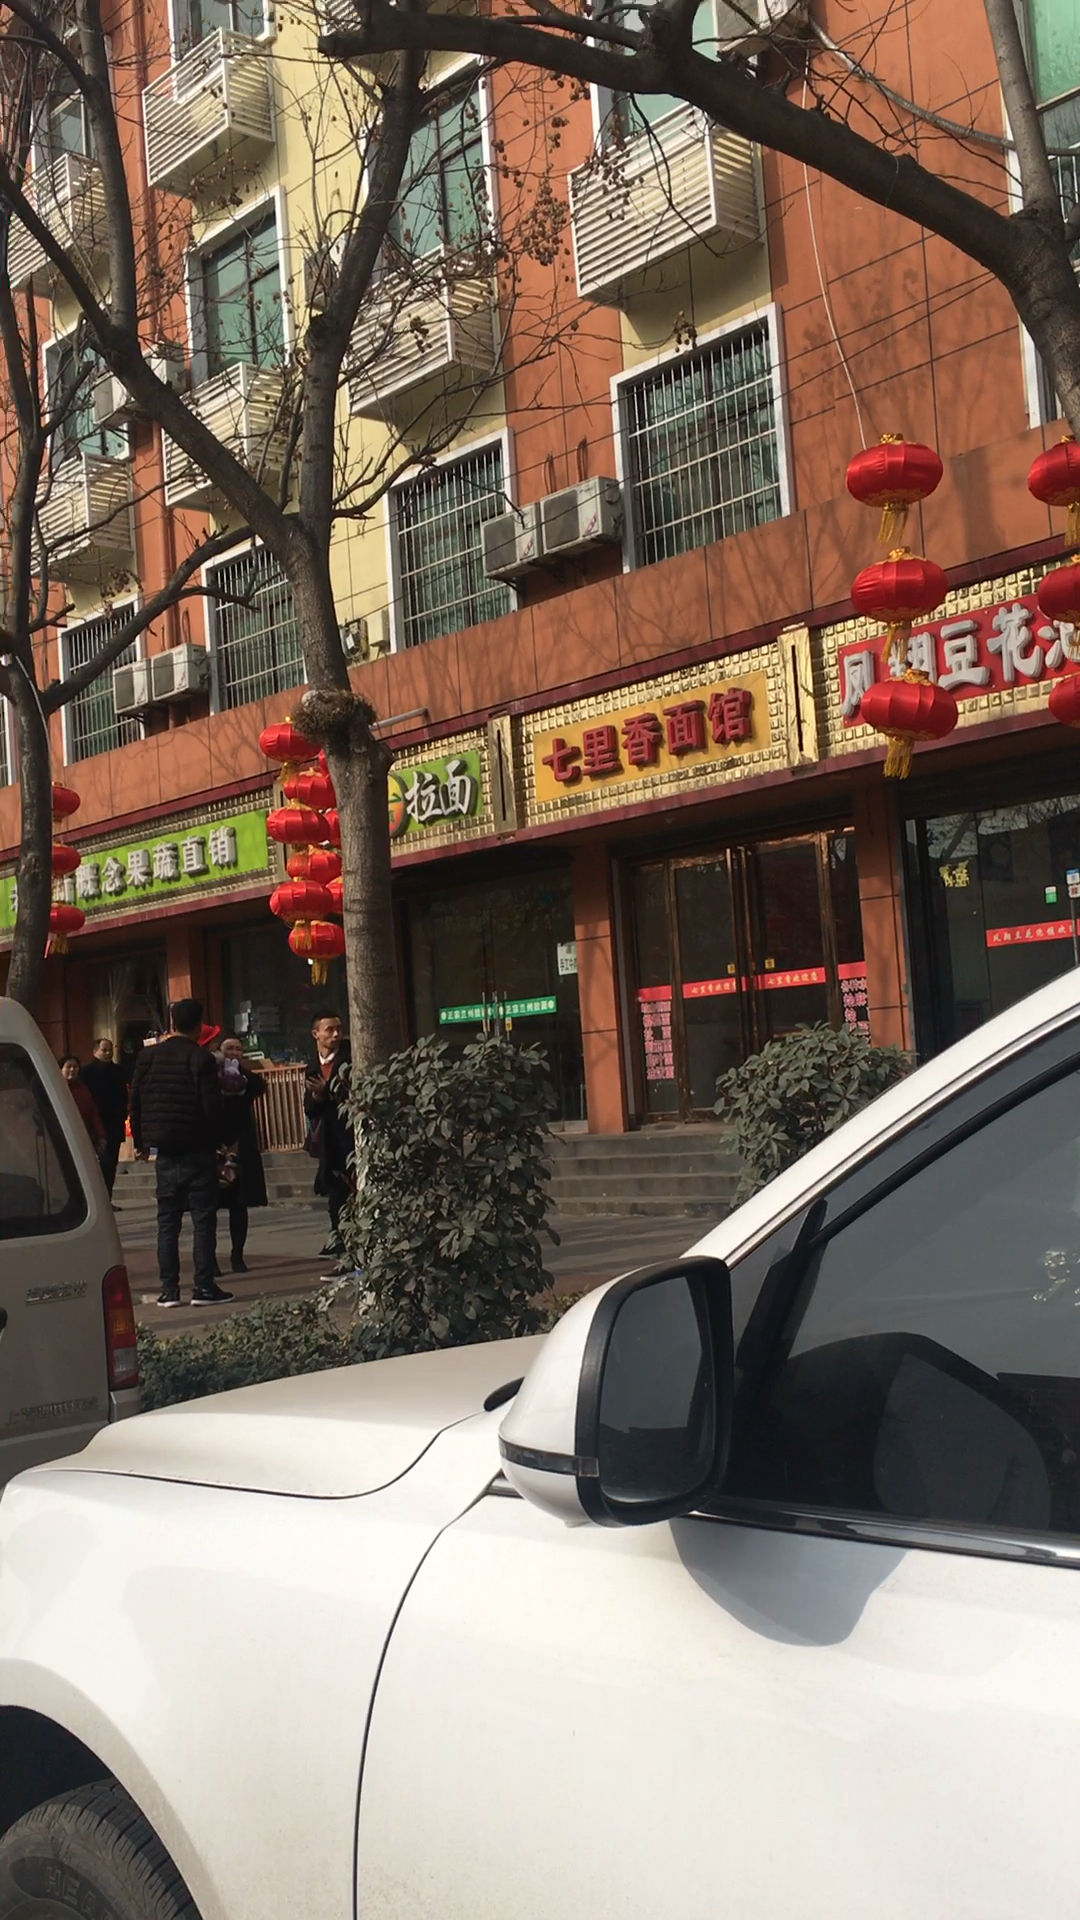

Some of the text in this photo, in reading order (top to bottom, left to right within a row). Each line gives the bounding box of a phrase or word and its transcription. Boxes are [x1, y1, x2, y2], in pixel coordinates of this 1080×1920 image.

[542, 687, 754, 783] 七里香面馆
[405, 759, 479, 824] 拉面
